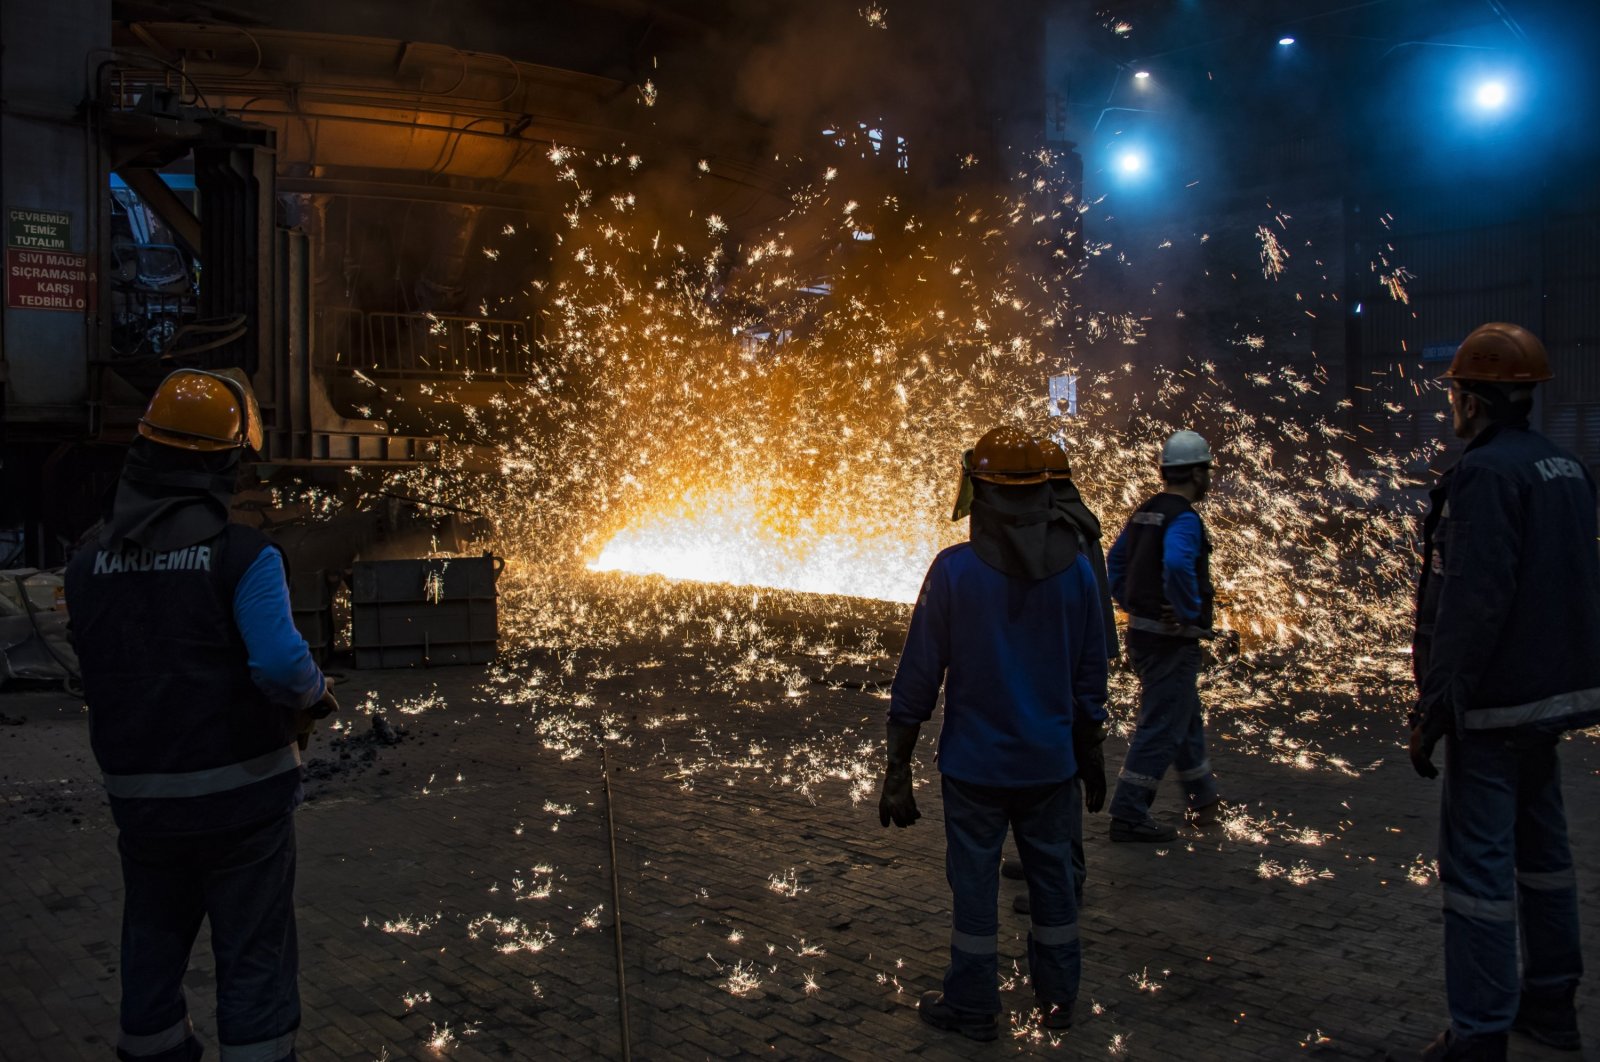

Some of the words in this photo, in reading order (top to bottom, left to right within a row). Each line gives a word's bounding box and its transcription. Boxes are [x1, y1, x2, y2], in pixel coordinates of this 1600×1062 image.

[23, 224, 57, 236] TEMİZ
[15, 235, 65, 248] TUTALIM
[19, 252, 43, 264] SIVI
[37, 282, 74, 296] KARŞI
[19, 295, 73, 308] TEDBİRLİ
[75, 298, 87, 308] O
